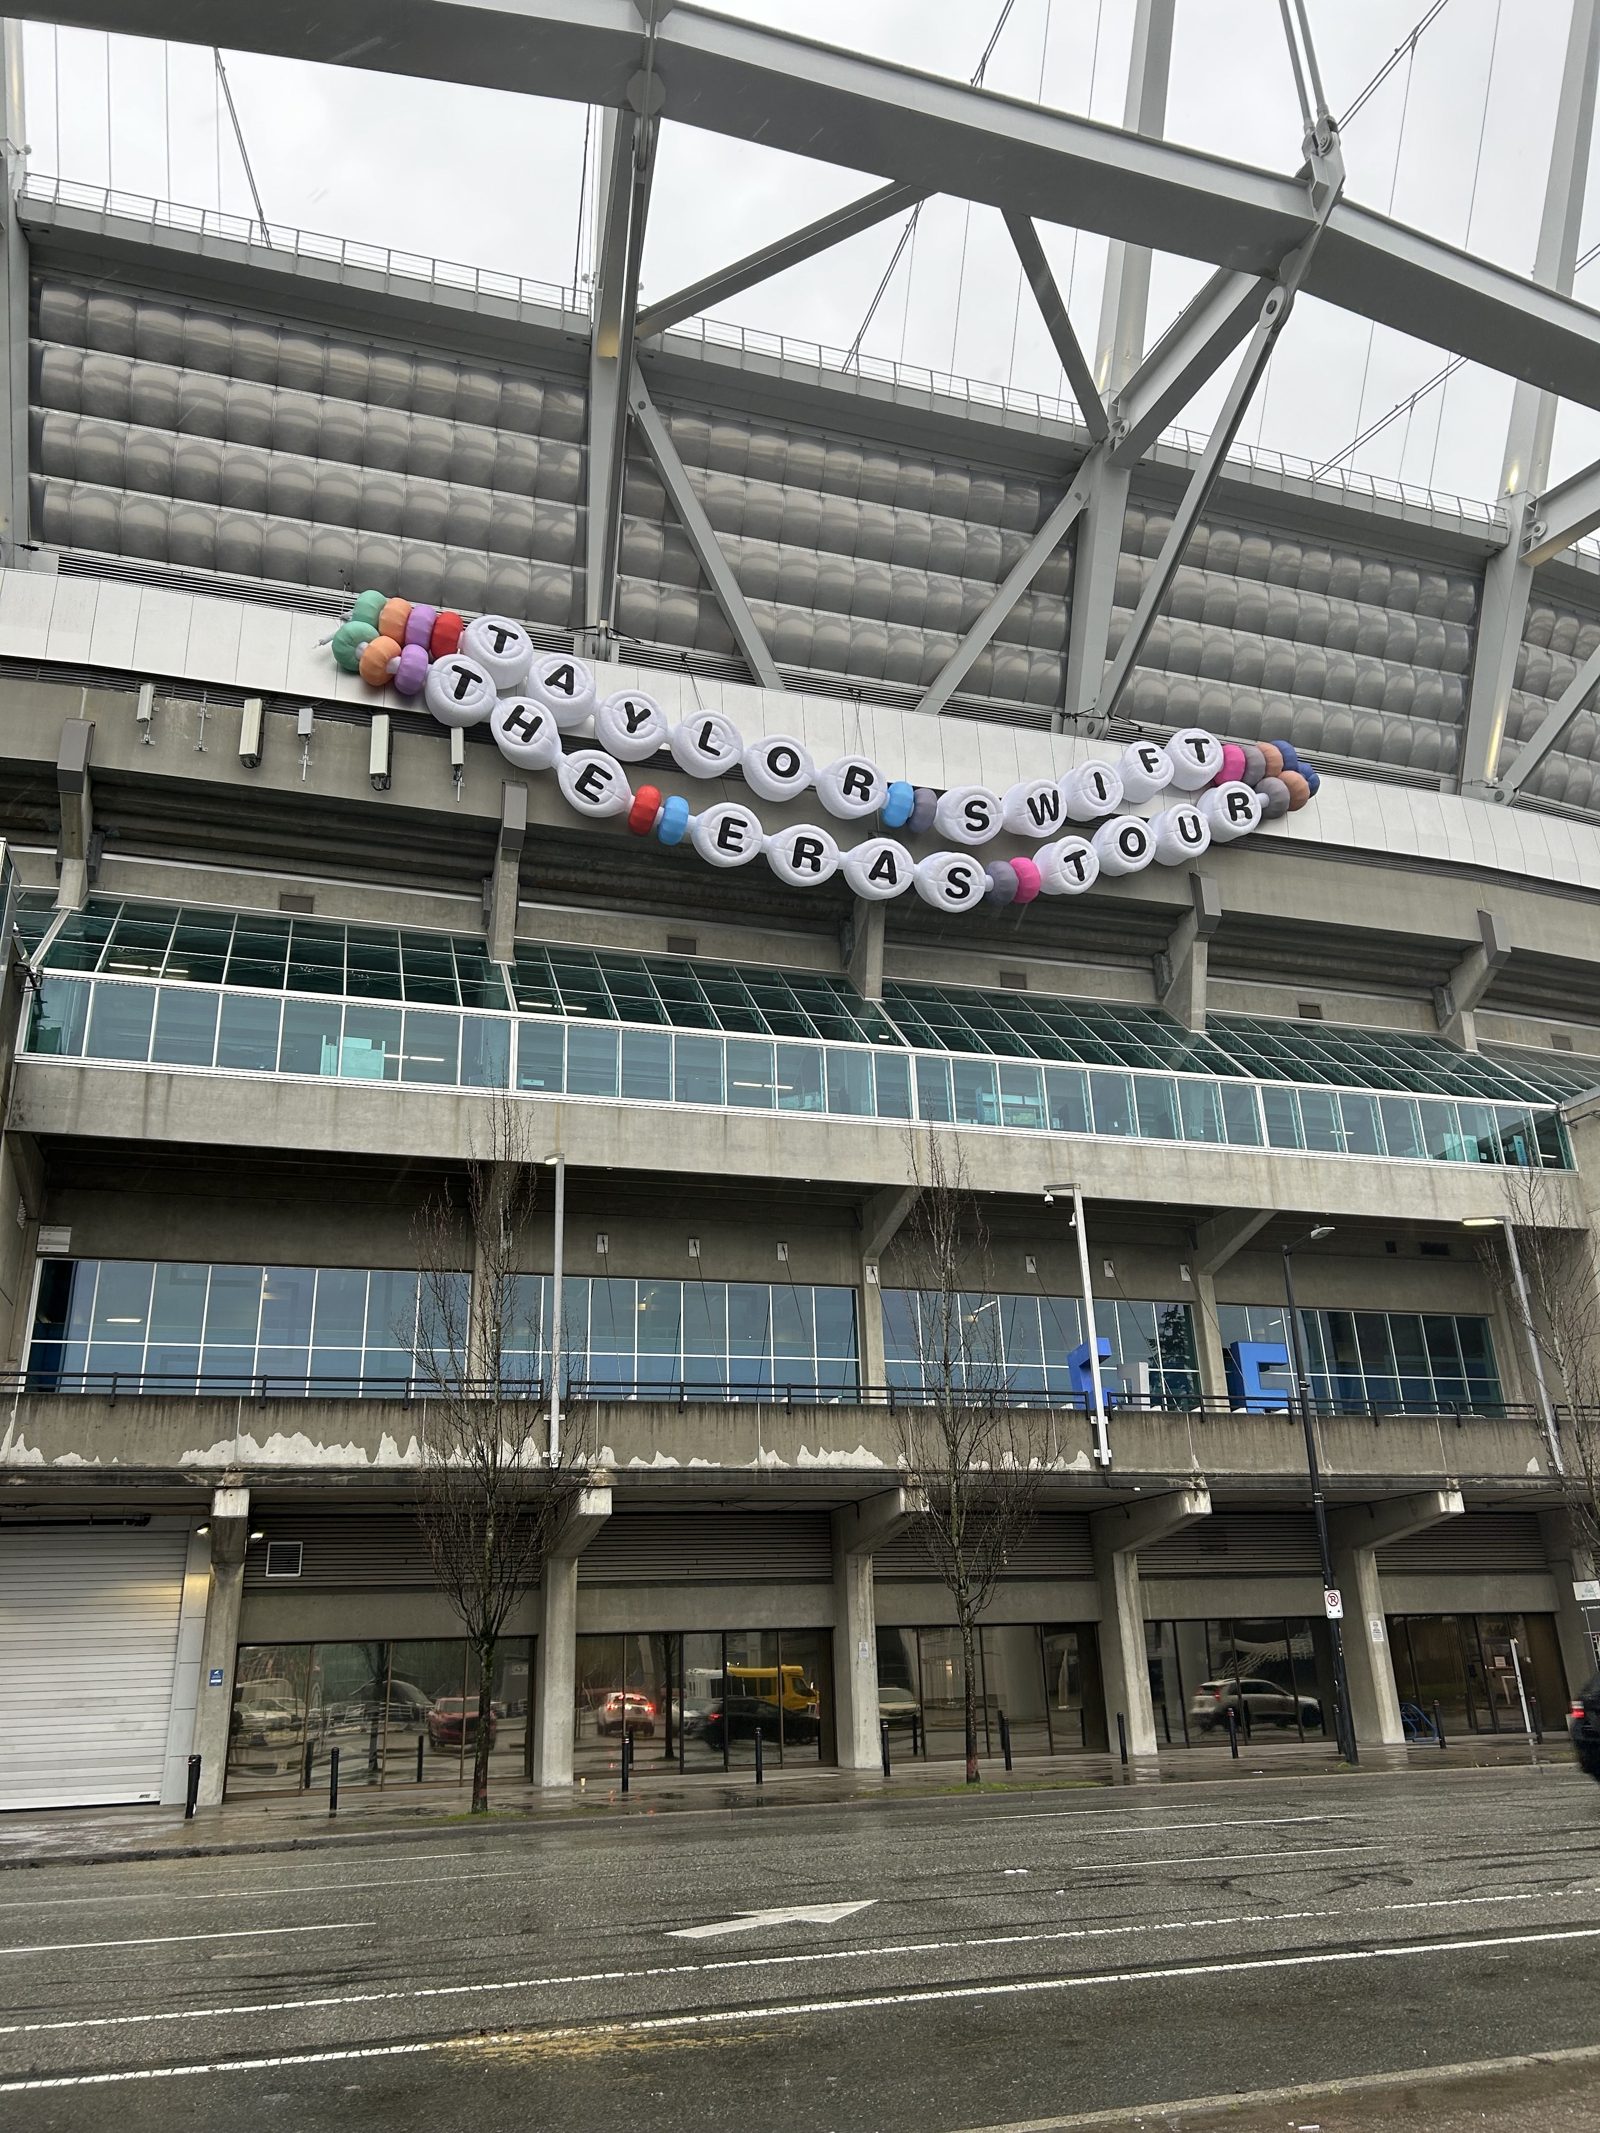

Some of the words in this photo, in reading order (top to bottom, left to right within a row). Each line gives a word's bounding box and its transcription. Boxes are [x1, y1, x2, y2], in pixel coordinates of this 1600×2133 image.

[451, 665, 613, 803] THE
[717, 816, 971, 899] ERAS
[1063, 791, 1253, 882] TOUR
[487, 624, 874, 801] TAYLOR
[964, 737, 1210, 832] SWIFT
